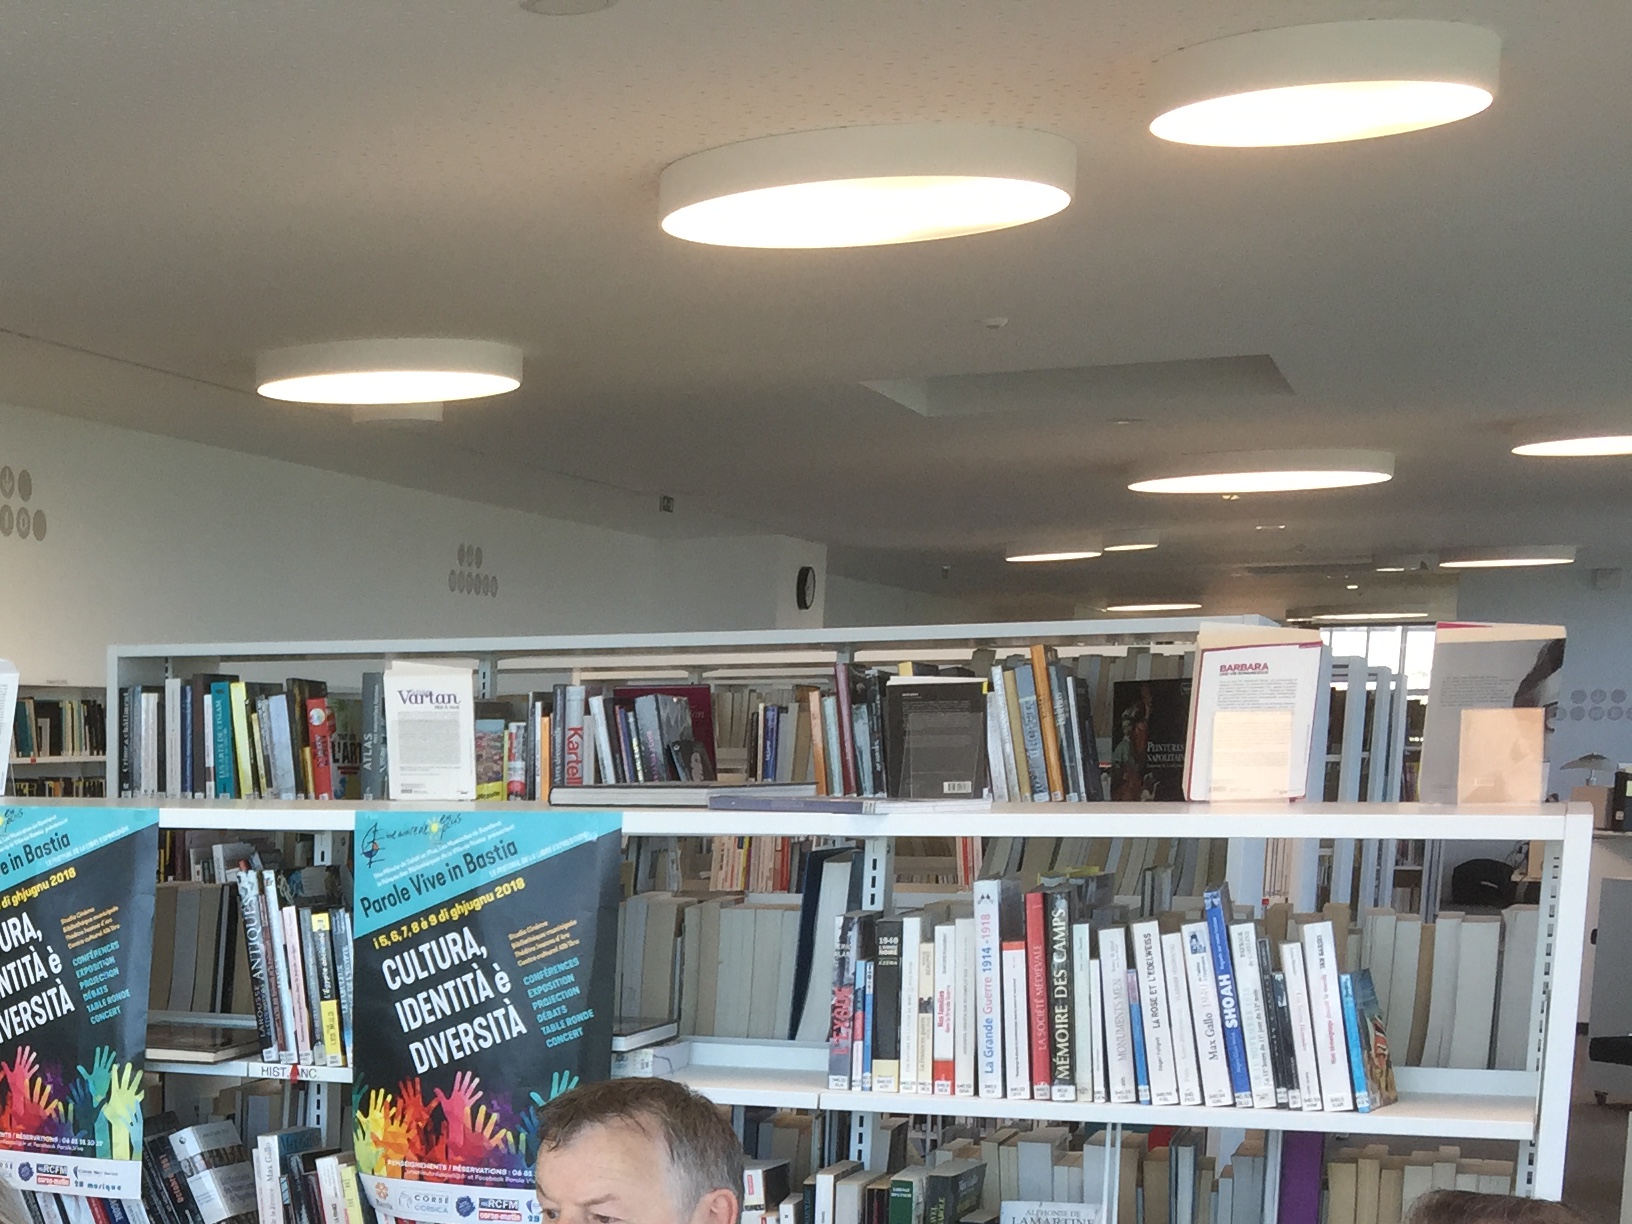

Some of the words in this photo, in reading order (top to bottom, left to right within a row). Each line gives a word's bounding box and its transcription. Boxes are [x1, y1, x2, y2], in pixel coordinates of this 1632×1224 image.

[1220, 663, 1268, 672] BARBARA
[398, 690, 461, 709] Vartan
[364, 732, 373, 770] ATLAS
[9, 853, 24, 871] in
[23, 833, 71, 864] Bastia
[50, 867, 76, 887] 2018
[360, 884, 411, 918] Parole
[409, 871, 446, 896] Vive
[445, 861, 464, 882] in
[463, 839, 518, 874] Bastia
[450, 891, 495, 921] ghjugnu
[494, 877, 526, 899] 2018
[1051, 908, 1066, 962] CAMPS
[47, 946, 62, 974] è
[382, 926, 487, 990] CULTURA,
[523, 956, 580, 985] CONFÉRENCES
[982, 947, 992, 972] 1914
[1033, 944, 1044, 995] MÉDIÉVALE
[1143, 932, 1156, 982] L'EDELWEISS
[395, 962, 494, 1033] IDENTITÀ
[492, 962, 512, 993] è
[527, 974, 574, 998] EXPOSITION
[983, 977, 993, 1014] Guerre
[1054, 969, 1068, 998] DES
[1112, 978, 1122, 997] MEN
[1148, 985, 1157, 994] ET
[255, 985, 264, 1037] LAROUSSE
[532, 986, 580, 1010] PROJECTION
[1149, 997, 1159, 1016] ROSE
[1218, 974, 1238, 1028] SHOAH
[537, 1004, 567, 1023] DÉBATS
[541, 1019, 567, 1035] TABLE
[566, 1009, 595, 1028] RONDE
[1034, 997, 1045, 1035] SOCIÉTÉ
[1151, 1017, 1161, 1028] LA
[1203, 1013, 1216, 1037] Gallo
[409, 998, 527, 1074] DIVERSITÀ
[546, 1027, 584, 1048] CONCERT
[983, 1018, 994, 1058] Grande
[1038, 1036, 1047, 1050] LA
[1051, 1005, 1070, 1079] MÉMOIRE
[1113, 1000, 1128, 1061] MONUMENTS
[1206, 1040, 1218, 1060] Max
[984, 1062, 994, 1073] La
[488, 1199, 518, 1210] RCFM
